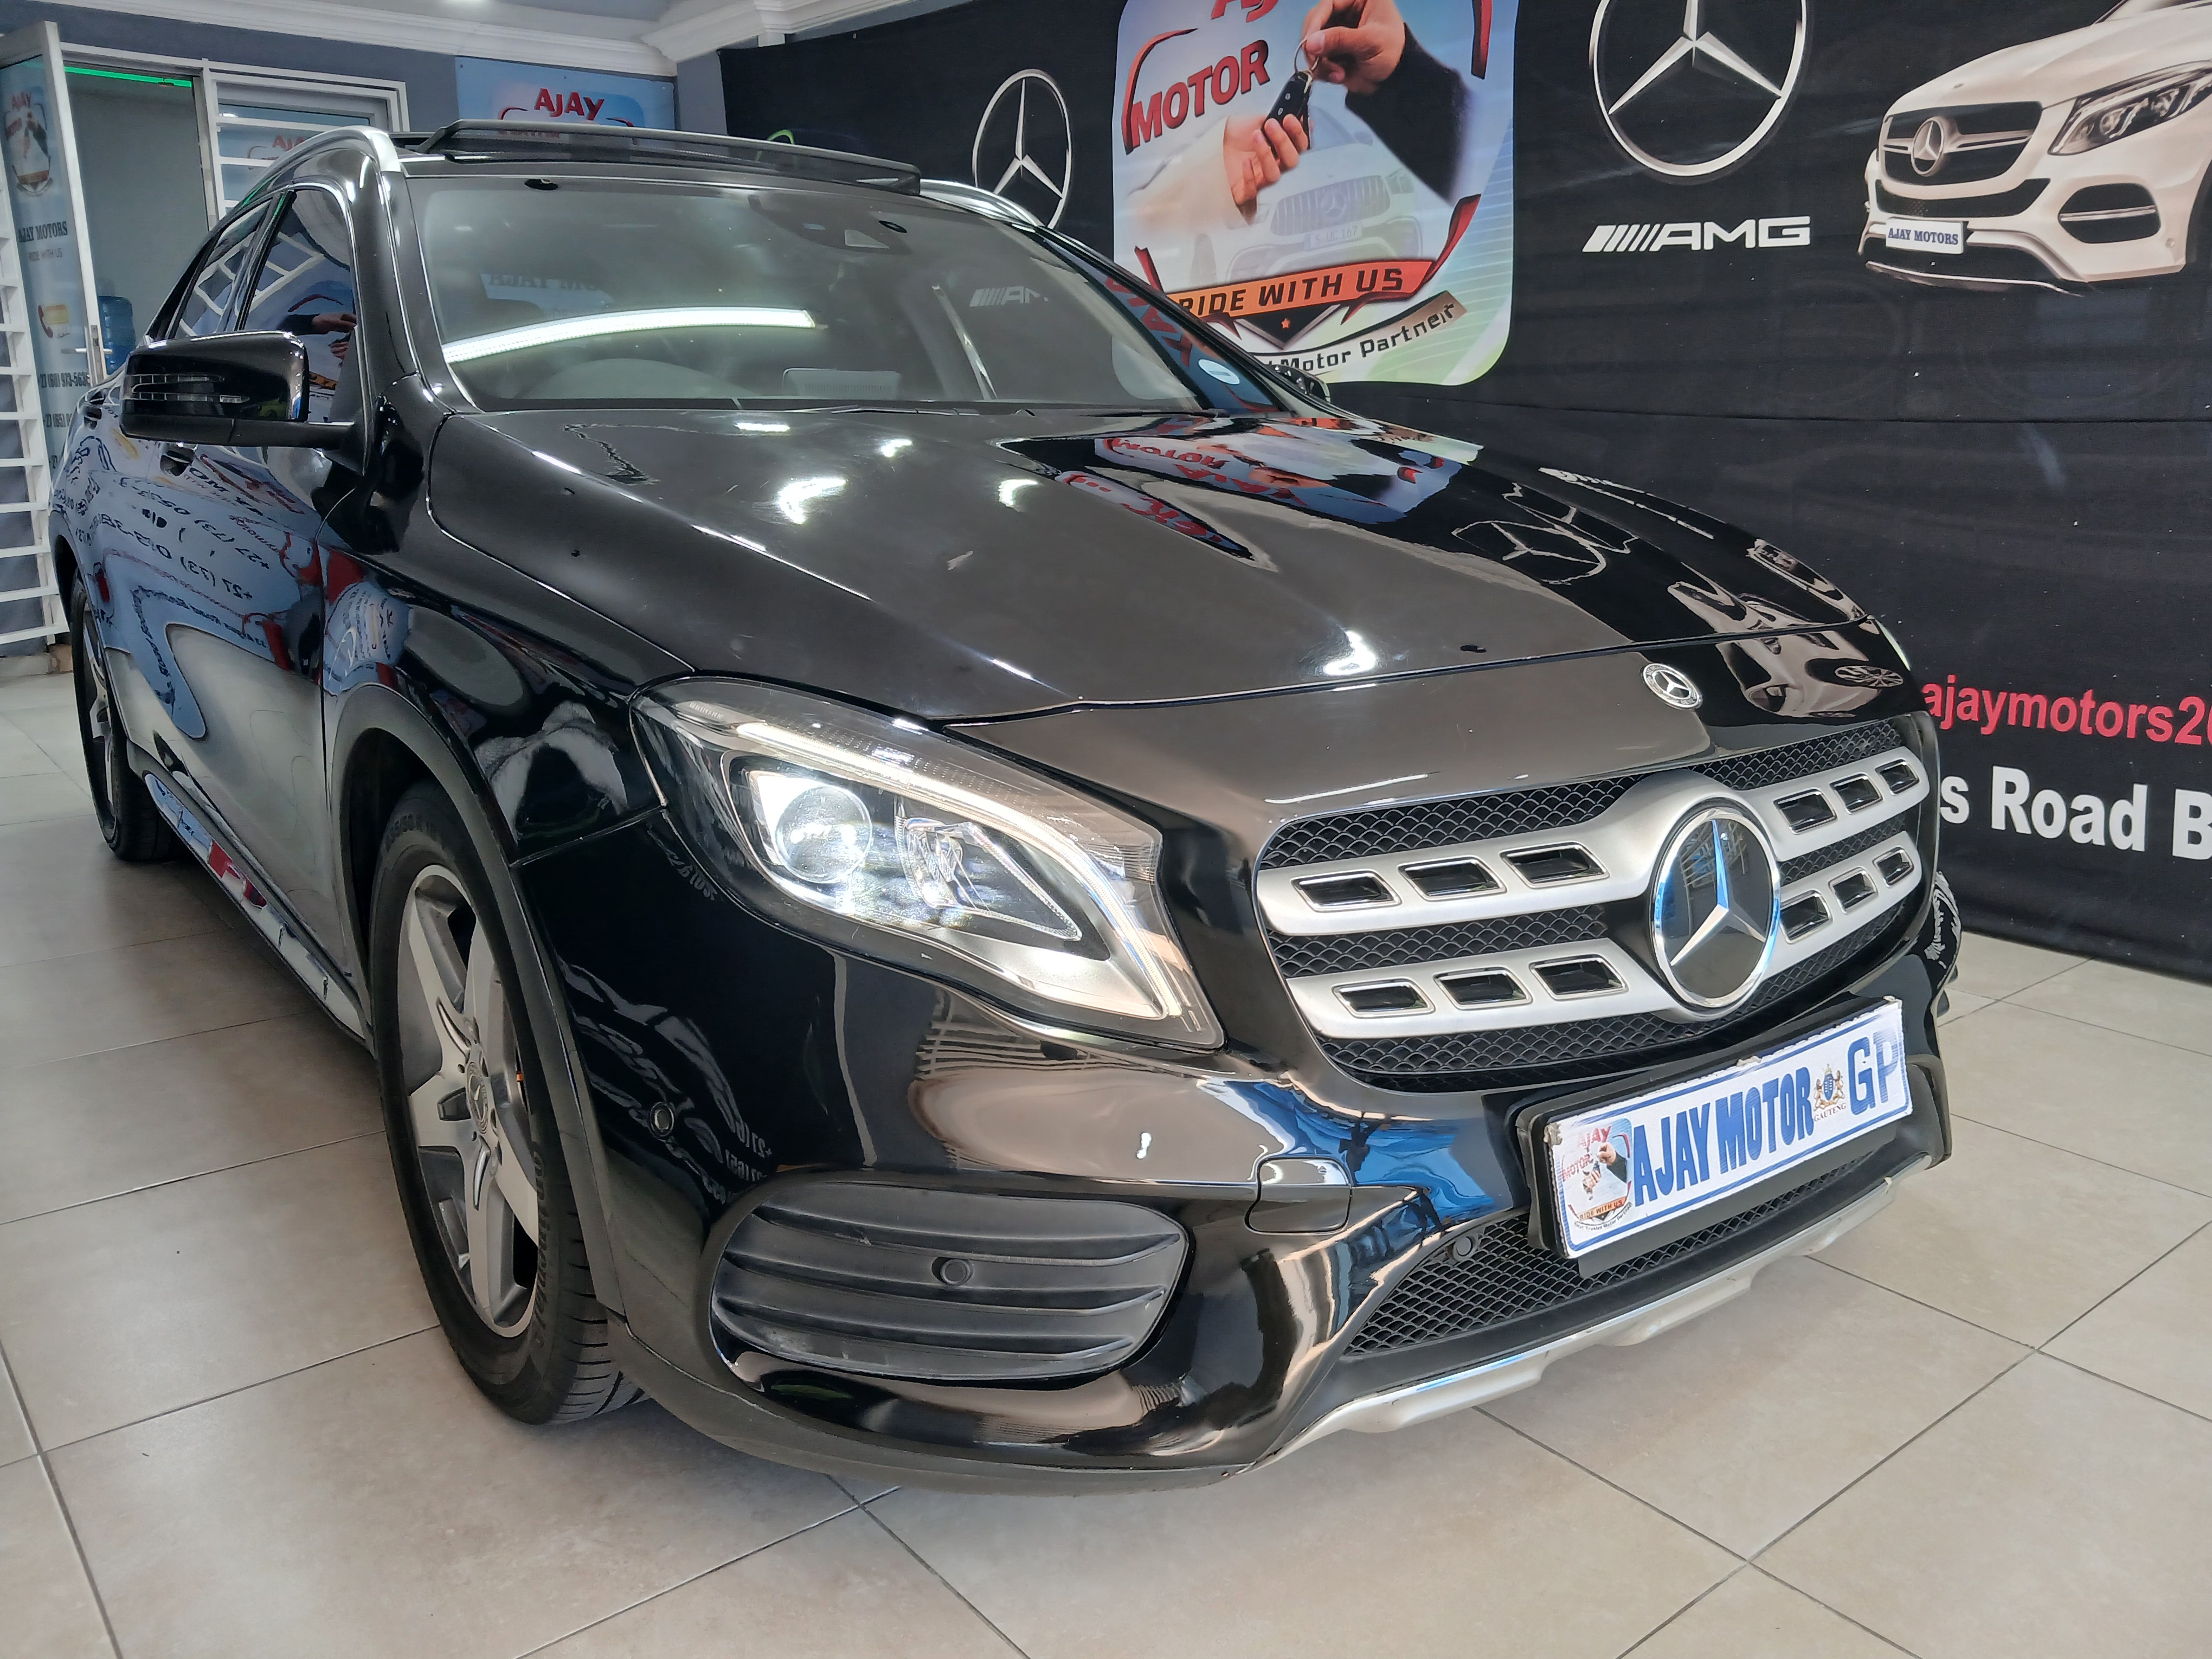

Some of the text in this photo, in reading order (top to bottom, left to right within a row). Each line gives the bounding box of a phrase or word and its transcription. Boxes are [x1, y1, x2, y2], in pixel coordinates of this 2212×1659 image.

[533, 87, 605, 121] AJAY
[1130, 39, 1270, 149] MOTOR
[18, 221, 68, 243] AJAY MOTORS
[1649, 216, 1811, 252] AMG
[1888, 228, 1958, 245] AJAY MOTORS
[1179, 268, 1403, 317] RIDE WITH US
[1359, 303, 1455, 358] Partner
[1921, 674, 2212, 746] ajaymotors2
[1991, 764, 2149, 852] Road
[1632, 1031, 1900, 1207] AJAY MOTOR GP
[1814, 1102, 1847, 1122] GAUTENG
[1578, 1126, 1612, 1148] AJAY
[1561, 1153, 1592, 1182] MOTOR
[1579, 1211, 1594, 1221] RIDE
[1596, 1203, 1612, 1214] WITH
